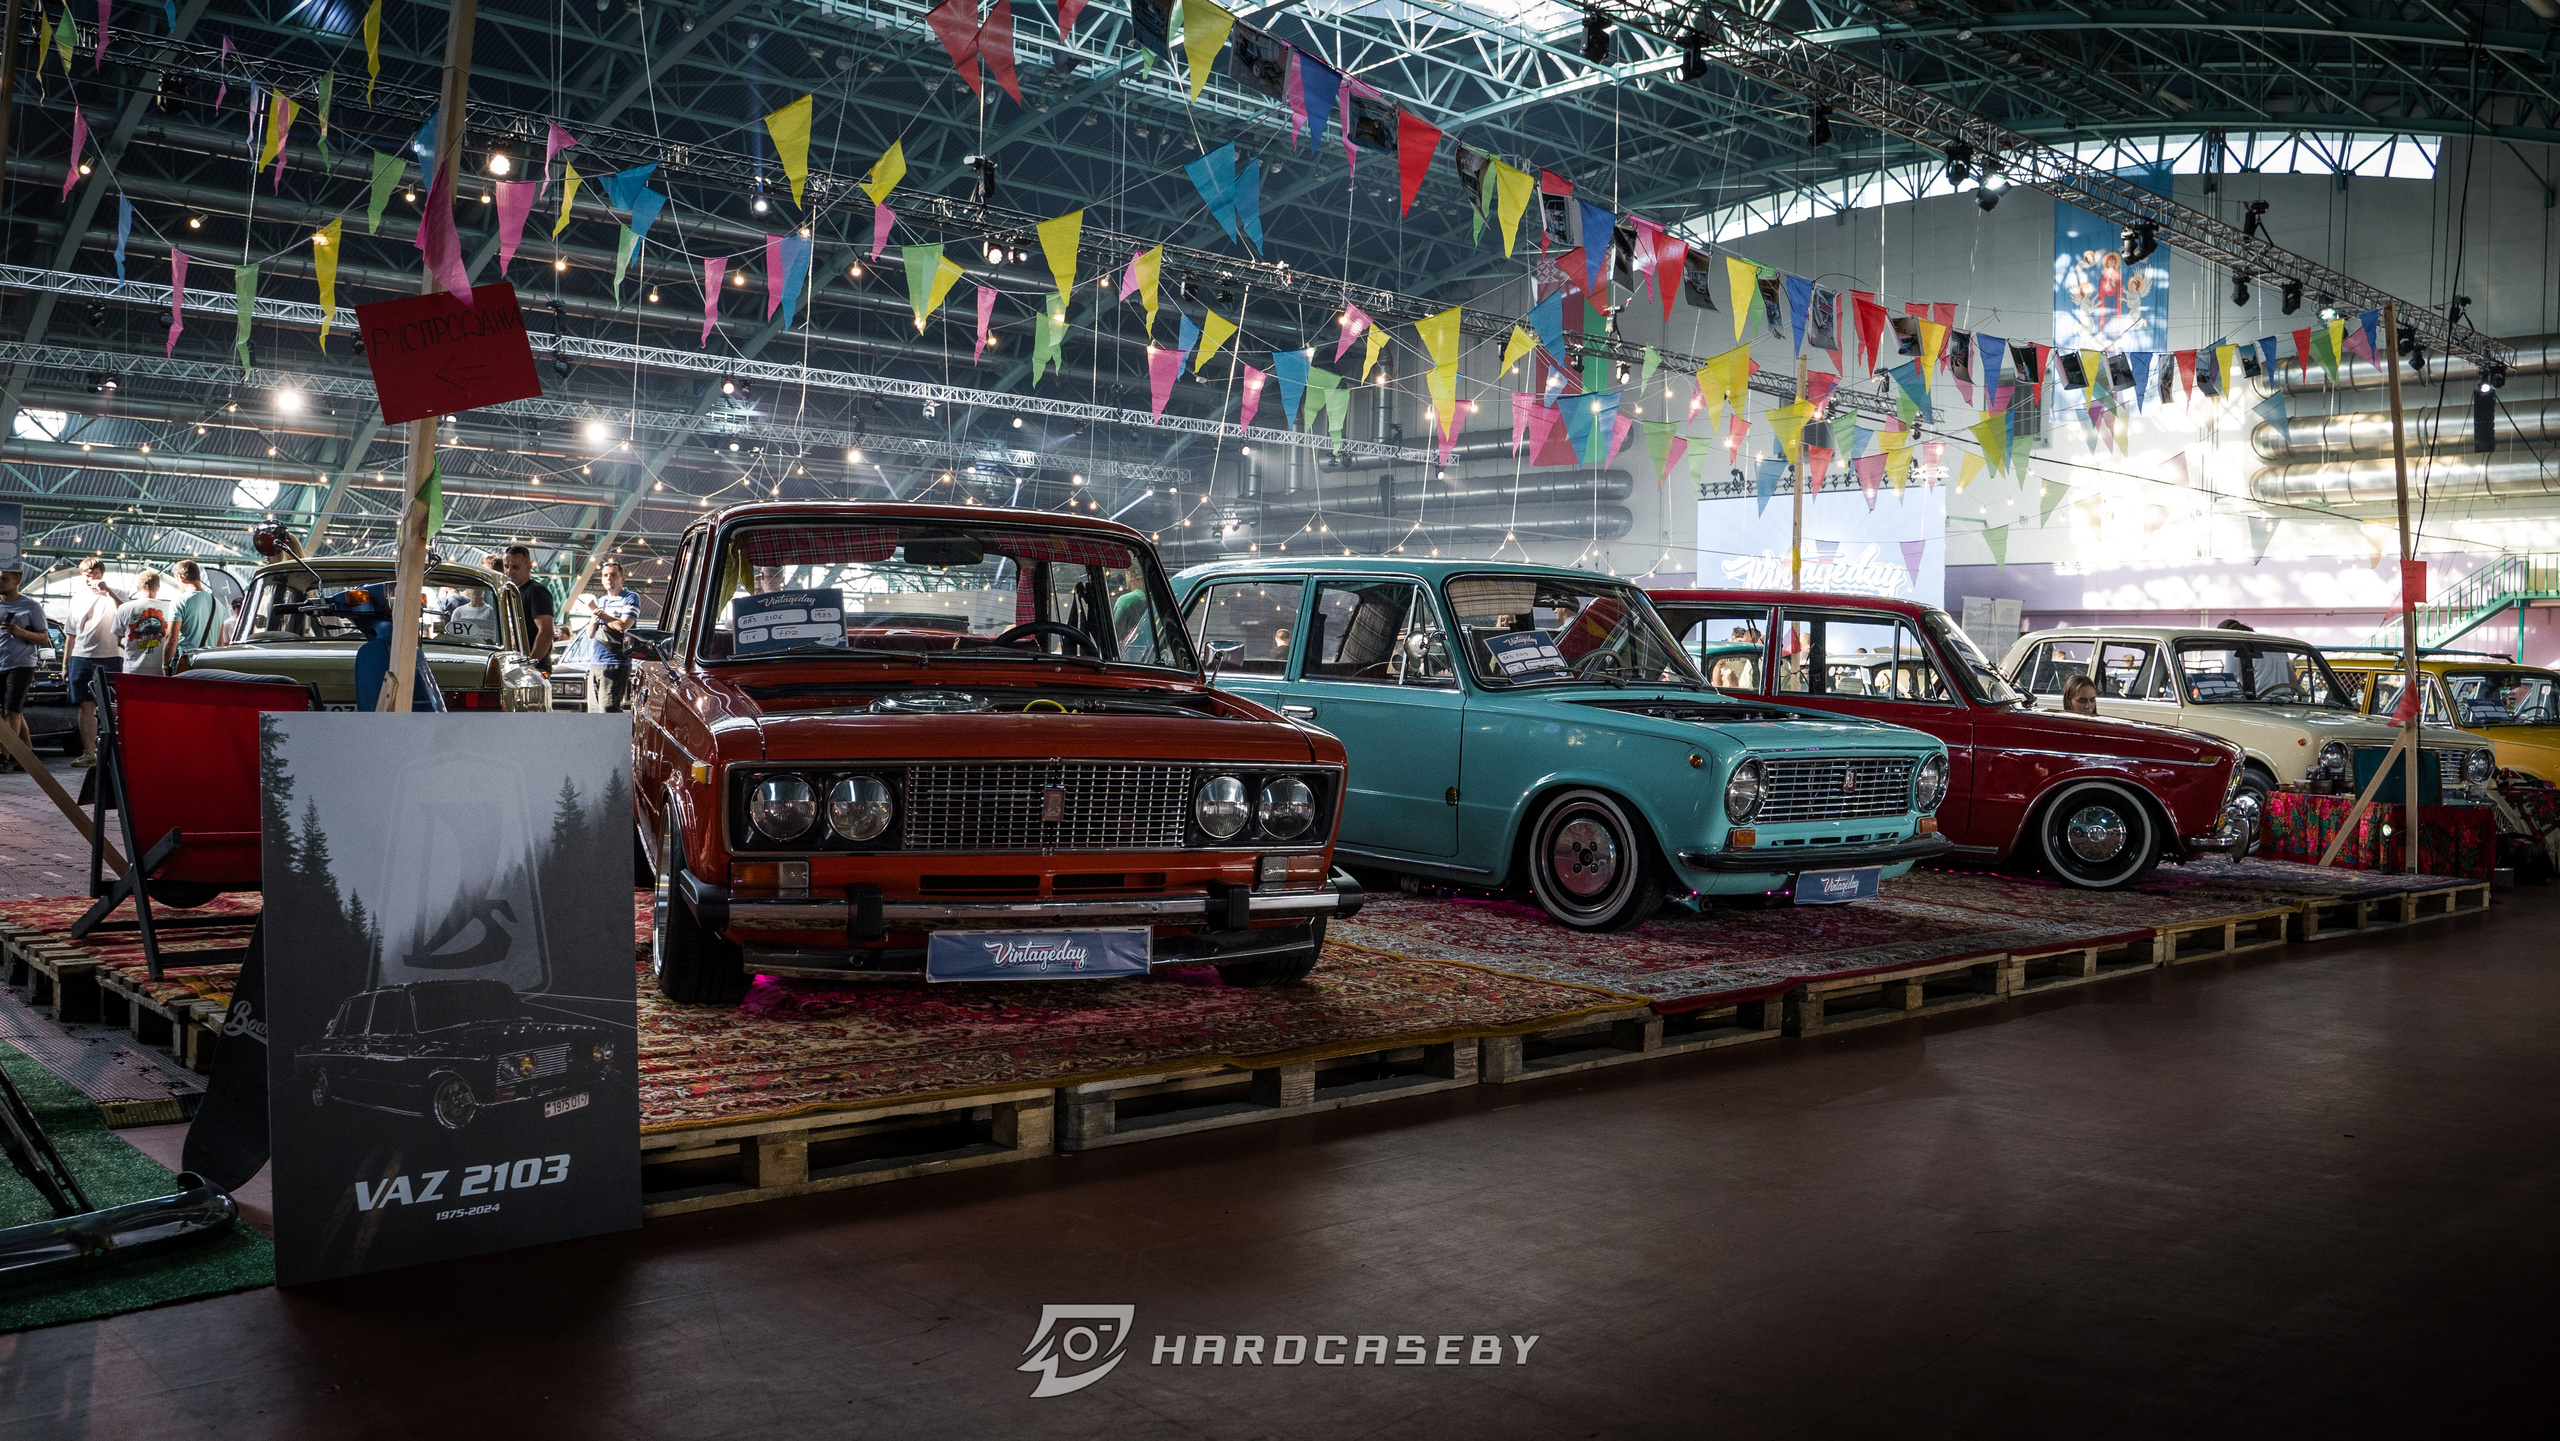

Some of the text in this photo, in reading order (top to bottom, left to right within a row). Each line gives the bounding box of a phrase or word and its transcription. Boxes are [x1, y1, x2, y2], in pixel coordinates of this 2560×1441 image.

[1721, 543, 1907, 596] Vinageday
[758, 594, 816, 607] Vintageday
[453, 622, 473, 636] BY
[1821, 874, 1860, 895] Vintageday
[984, 938, 1089, 972] Vintageday
[552, 1098, 570, 1114] 1975
[355, 1153, 571, 1212] VAZ 2103
[436, 1203, 501, 1221] 1975-2024
